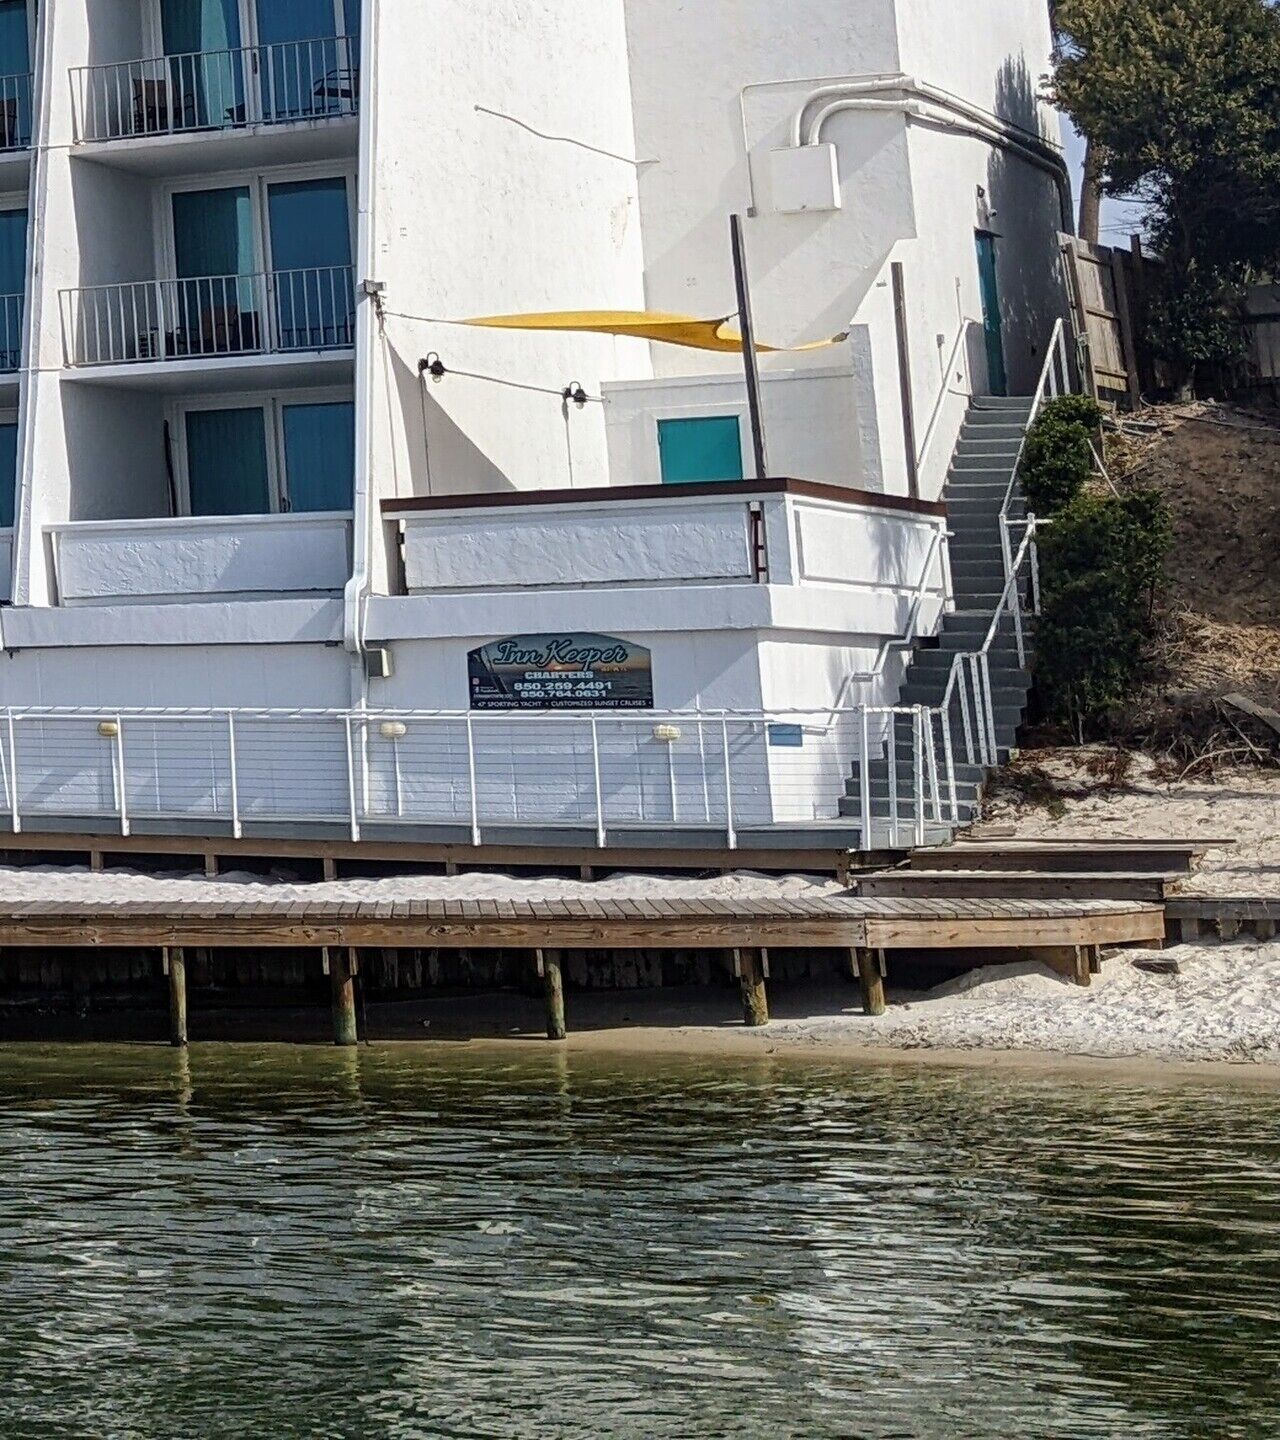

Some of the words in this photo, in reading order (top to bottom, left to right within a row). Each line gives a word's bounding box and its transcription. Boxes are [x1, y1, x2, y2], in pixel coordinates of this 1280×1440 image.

[495, 642, 540, 664] Inn
[537, 640, 627, 671] Keeper
[524, 671, 594, 679] CHARTERS
